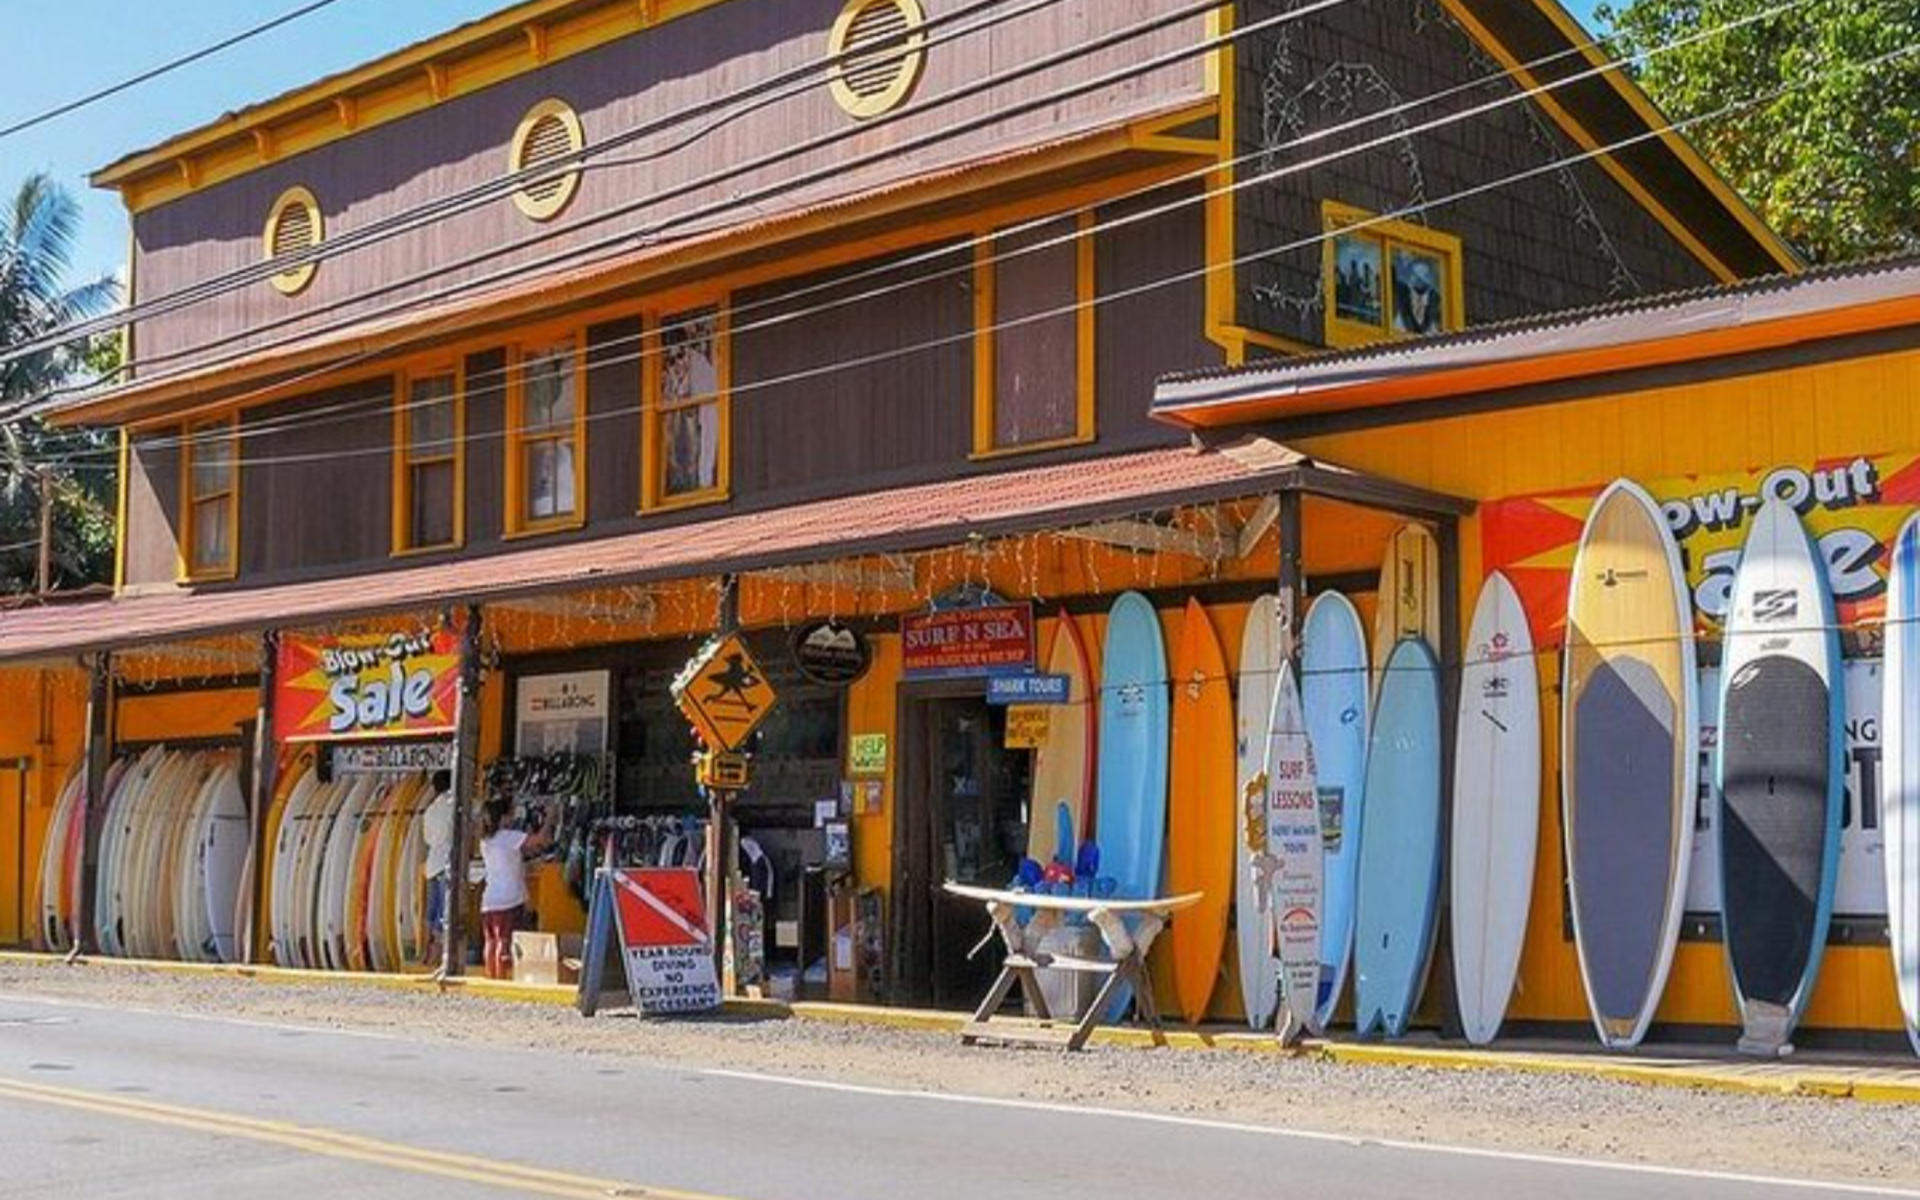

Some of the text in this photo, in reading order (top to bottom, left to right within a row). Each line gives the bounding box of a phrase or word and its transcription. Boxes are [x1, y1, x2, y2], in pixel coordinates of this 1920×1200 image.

[905, 624, 961, 650] SURF
[963, 622, 979, 643] N
[983, 619, 1025, 641] SEA
[322, 632, 432, 673] Blow-Out
[991, 677, 1062, 694] SHARK TOURS
[330, 659, 433, 732] Sale
[856, 737, 884, 755] HELP
[1279, 760, 1304, 779] SURF
[1271, 789, 1314, 810] LESSONS
[631, 947, 664, 958] YEAR
[652, 958, 697, 973] DIVING
[664, 971, 684, 983] NO
[640, 982, 717, 998] EXPERIENCE
[642, 997, 716, 1010] NECESSARY
